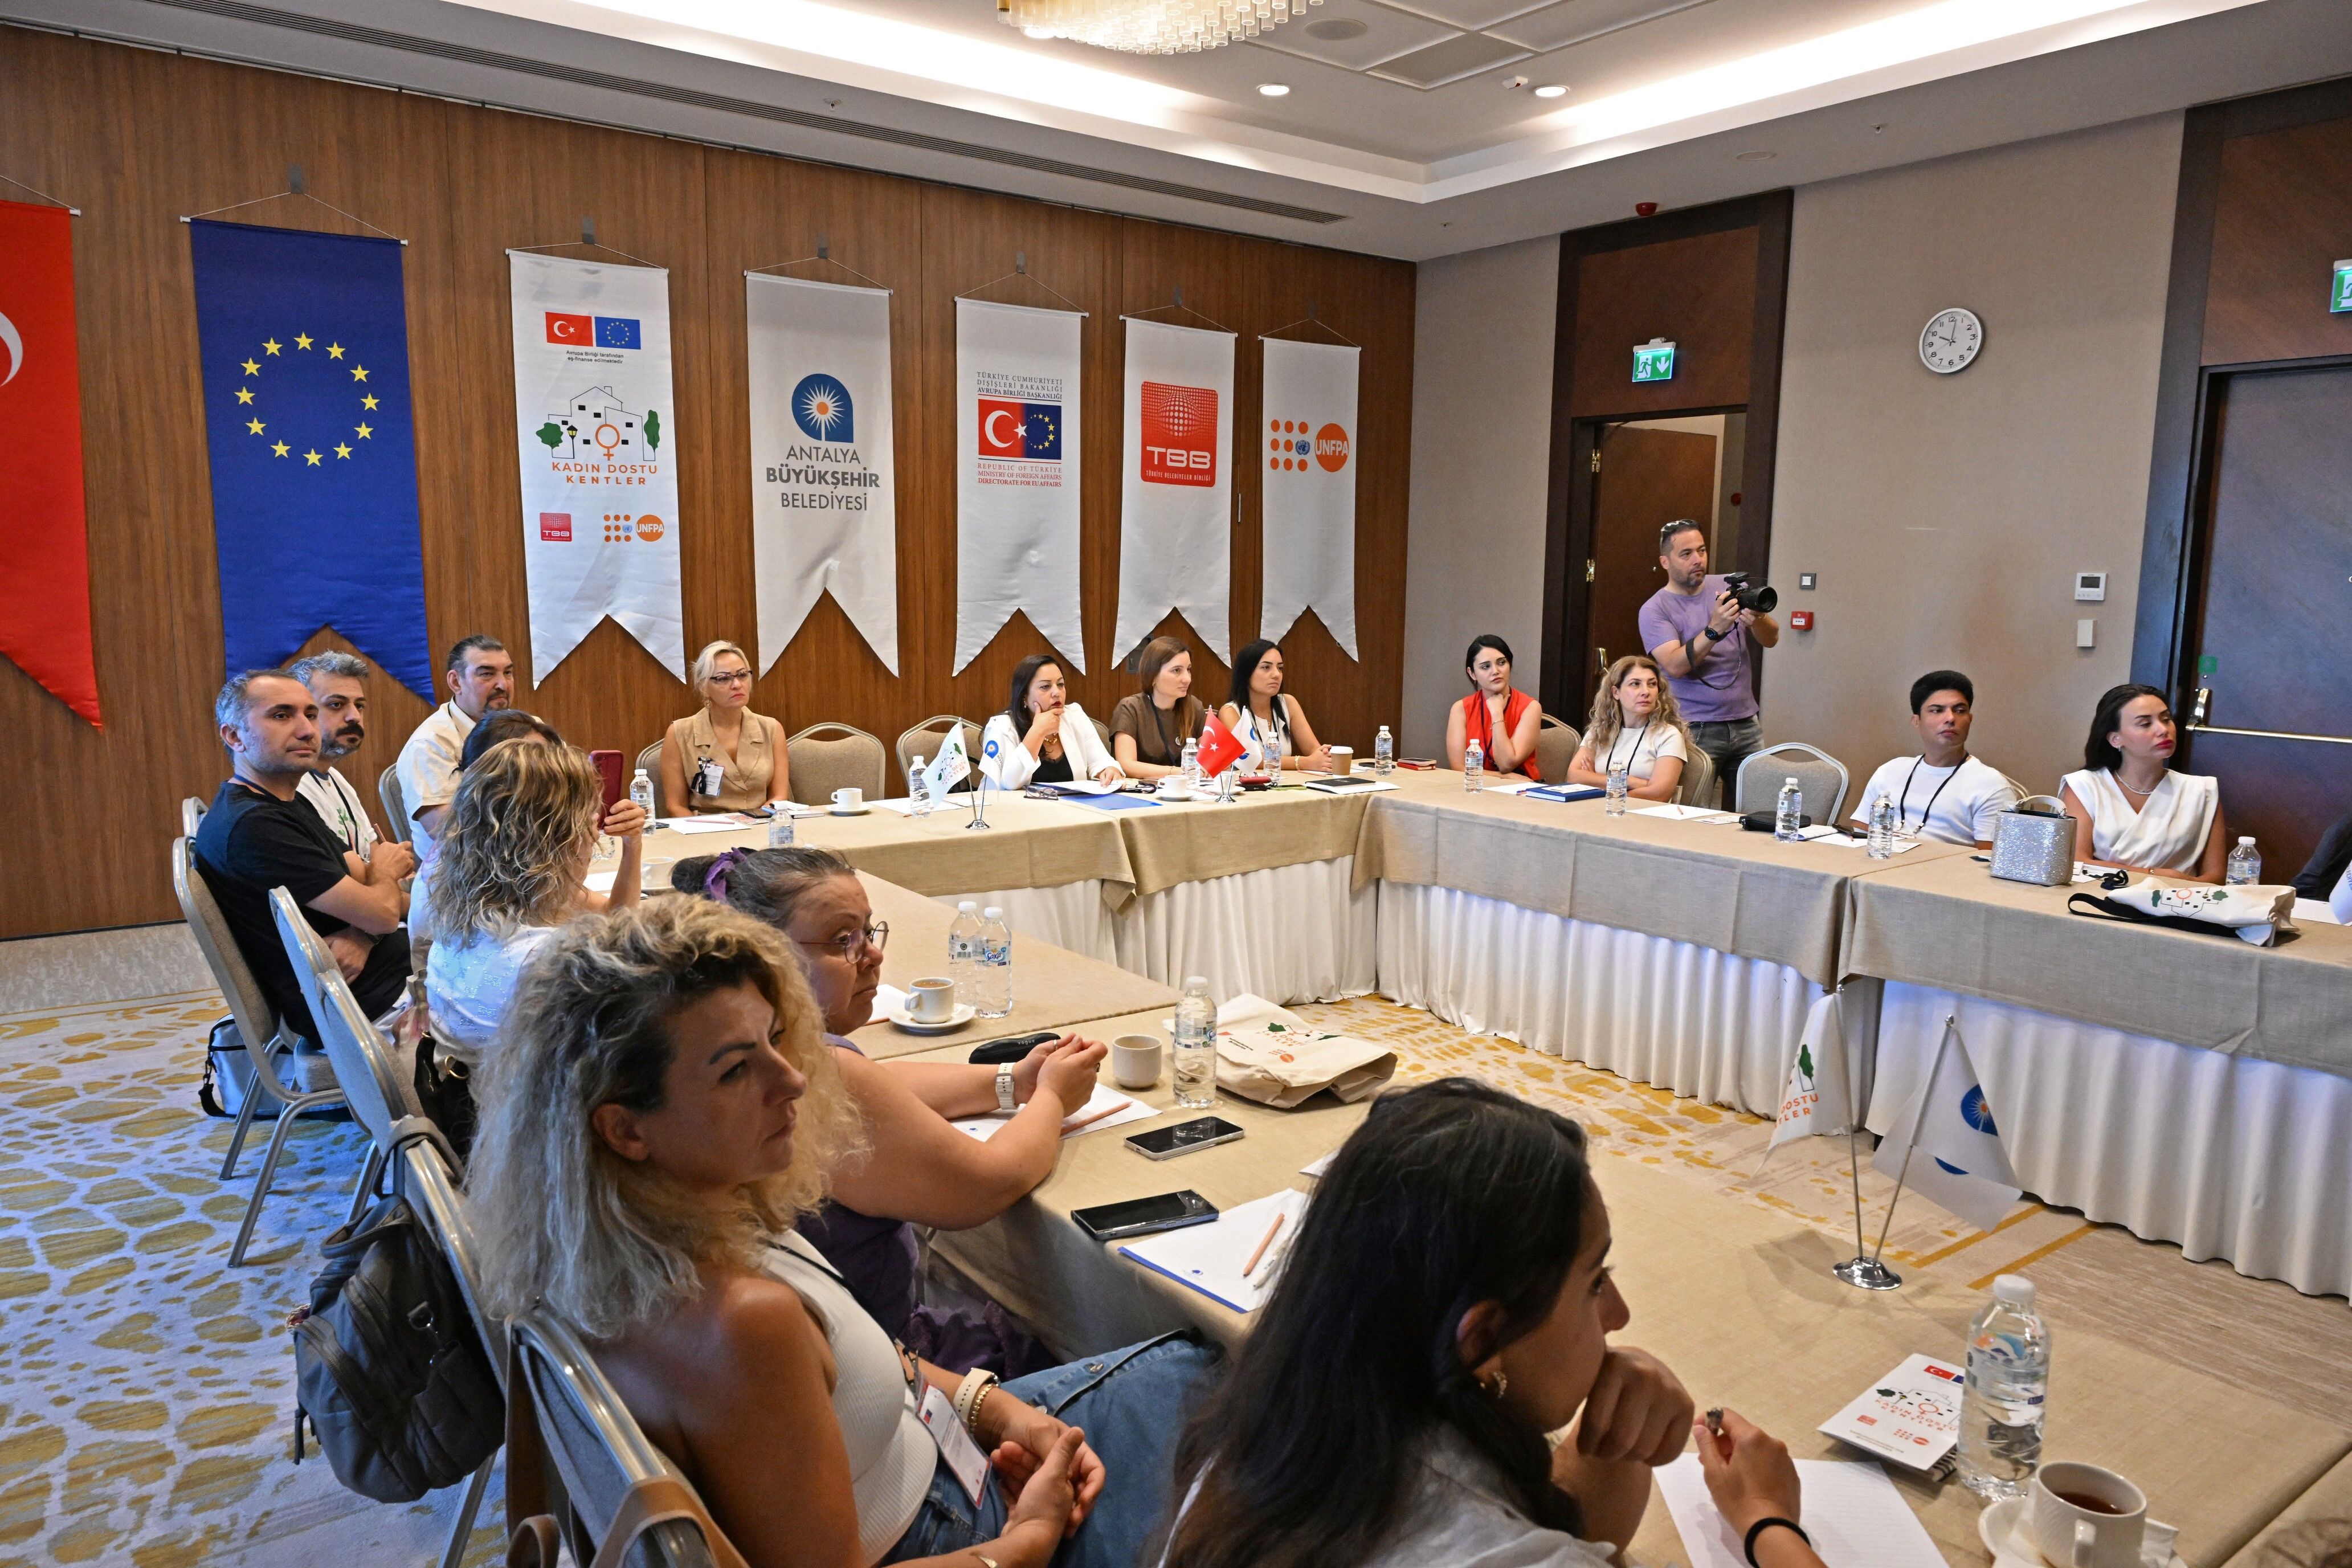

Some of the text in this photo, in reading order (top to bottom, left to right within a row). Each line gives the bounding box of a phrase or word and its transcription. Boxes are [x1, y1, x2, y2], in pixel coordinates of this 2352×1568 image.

[977, 371, 1062, 385] TÜRKİYE CUMHURİYETİ
[977, 379, 1062, 393] DIŞİŞLERİ BAKANLIĞI
[1027, 391, 1062, 400] BAŞKANLIĞI
[786, 444, 861, 464] ANTALYA
[1315, 439, 1348, 456] UNFPA
[1146, 446, 1211, 469] TBB
[552, 462, 658, 475] KADIN DOSTU
[978, 463, 1015, 471] REPUBLIC
[565, 475, 646, 485] KENTLER
[766, 463, 880, 489] BÜYÜKŞEHİR
[781, 491, 867, 511] BELEDİYESİ
[636, 524, 664, 533] UNFPA
